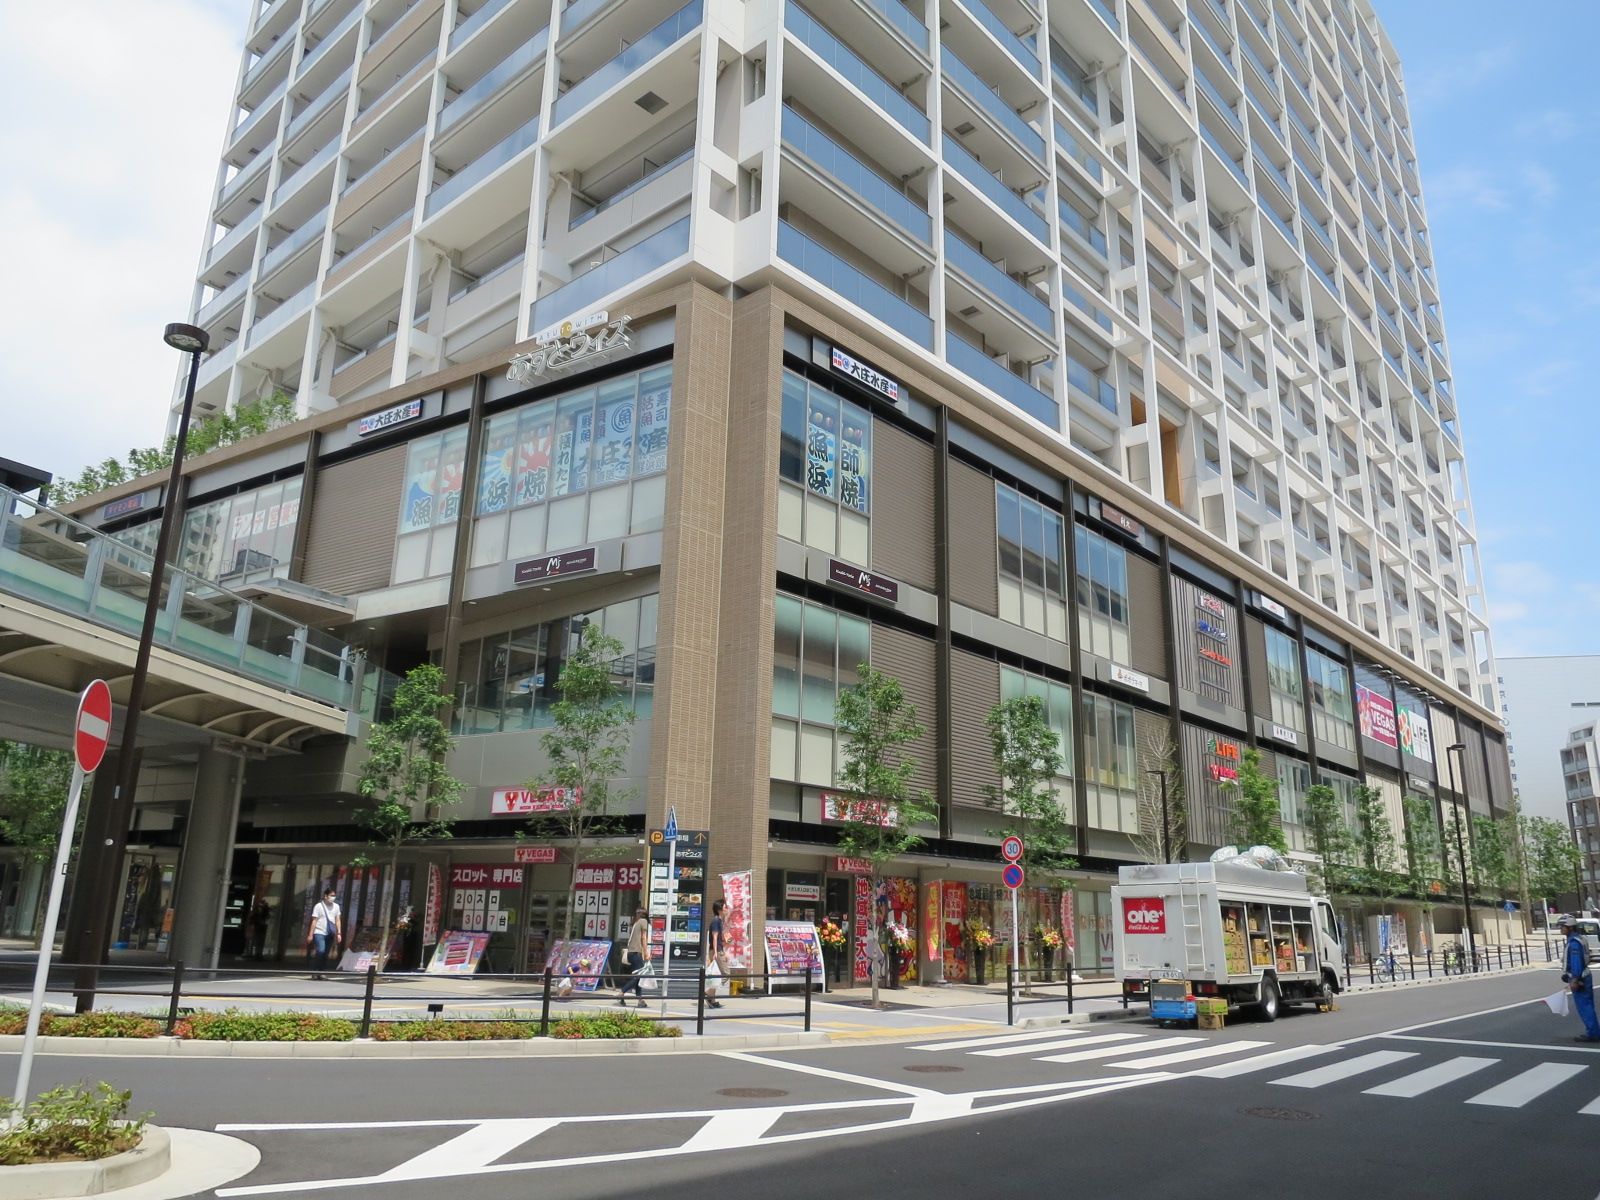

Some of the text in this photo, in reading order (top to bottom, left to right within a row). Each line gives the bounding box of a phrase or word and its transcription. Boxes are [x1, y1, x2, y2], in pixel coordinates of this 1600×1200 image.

[850, 361, 890, 395] 大庄水産
[1370, 708, 1396, 732] VEGAS
[1412, 722, 1429, 744] LIFE
[526, 849, 553, 858] VEGAS
[1006, 843, 1019, 854] 30
[453, 868, 522, 884] スロット 専門店
[576, 868, 614, 884] 設置台数
[577, 893, 609, 908] 5スロ
[855, 880, 869, 979] 地域最大級
